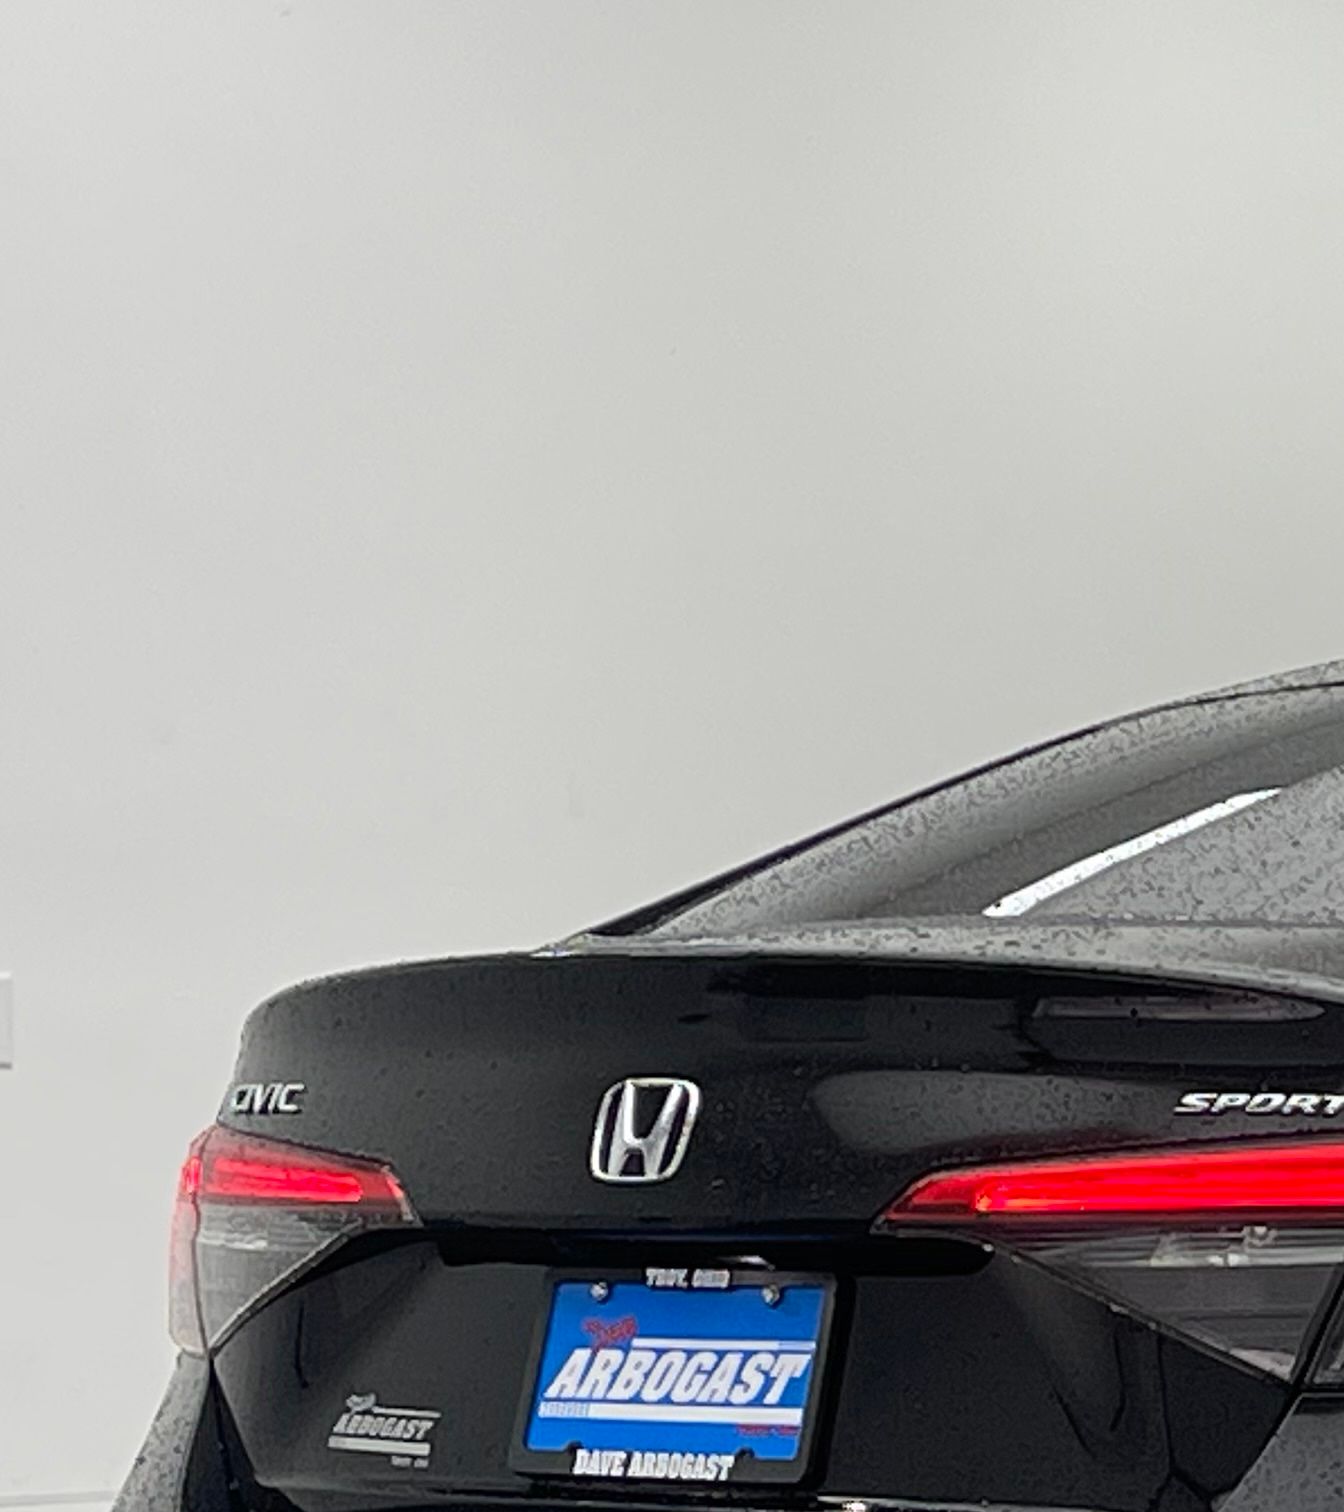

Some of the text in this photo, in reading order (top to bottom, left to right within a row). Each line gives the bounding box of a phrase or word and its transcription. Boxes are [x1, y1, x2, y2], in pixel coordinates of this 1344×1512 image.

[231, 1083, 305, 1112] CIVIC
[544, 1348, 812, 1405] ARBOGAST
[333, 1413, 434, 1440] ARBOGAST
[573, 1449, 735, 1481] DAVE ARBOGAST
